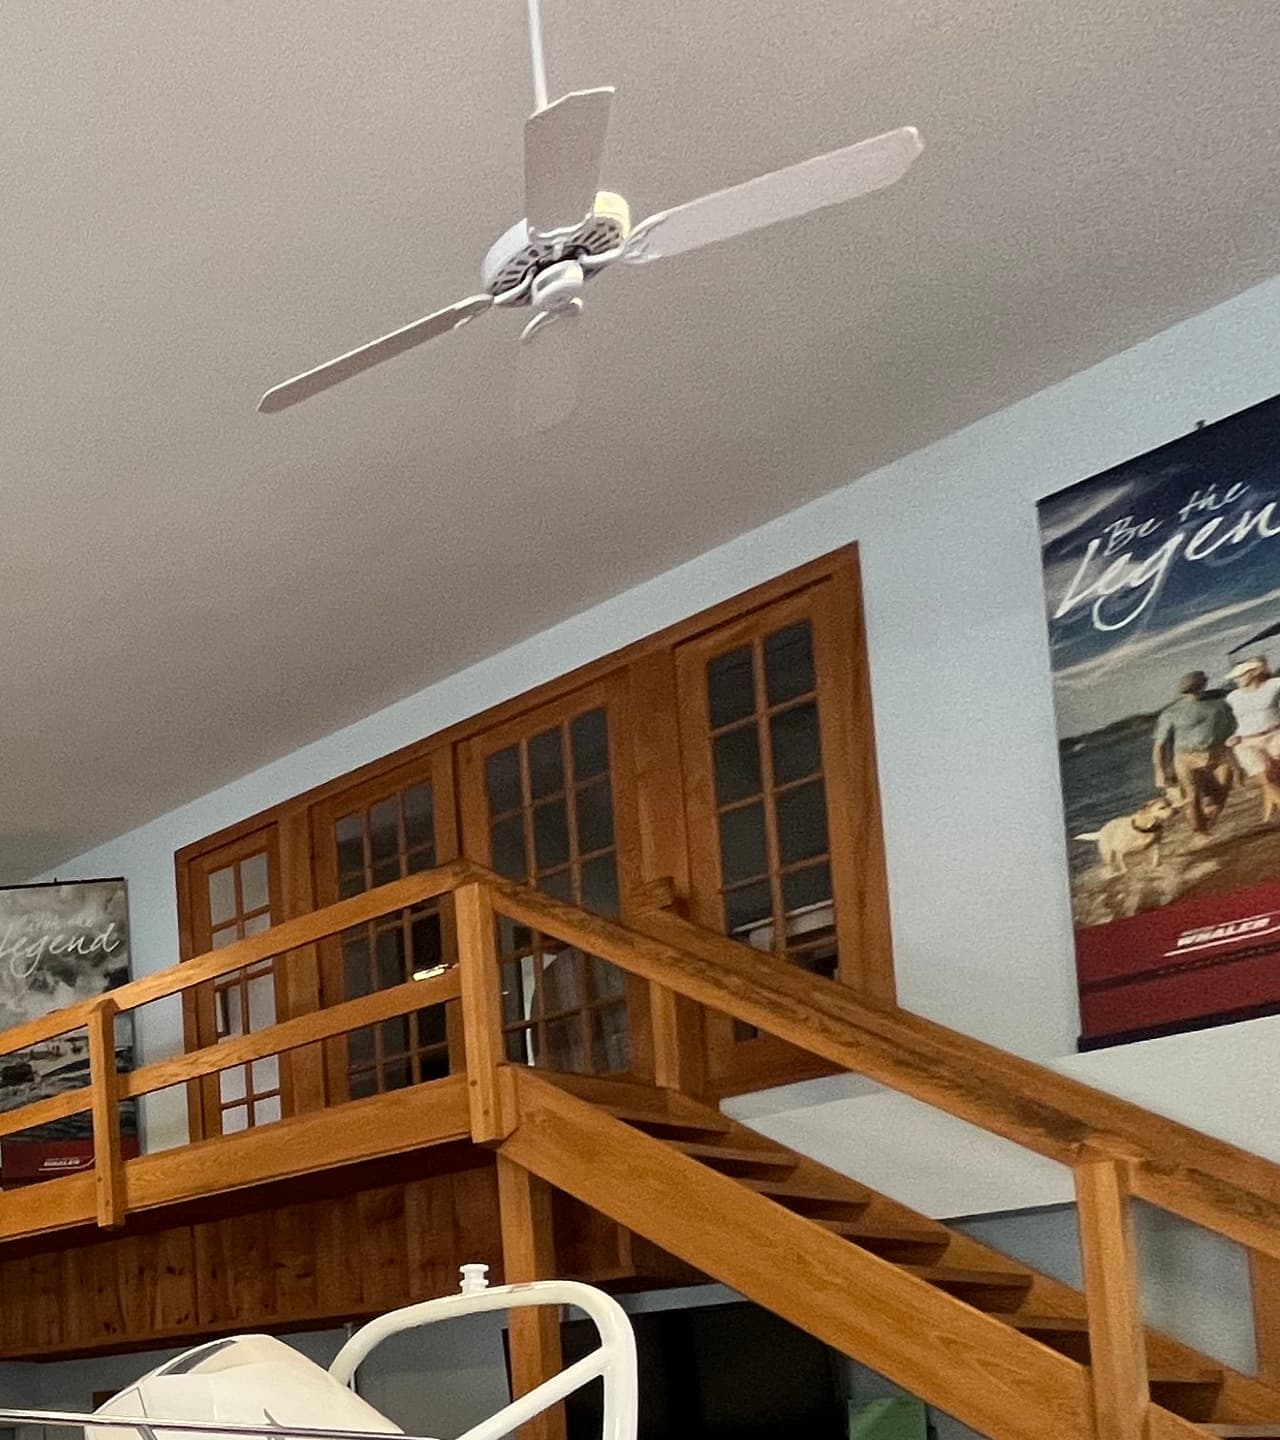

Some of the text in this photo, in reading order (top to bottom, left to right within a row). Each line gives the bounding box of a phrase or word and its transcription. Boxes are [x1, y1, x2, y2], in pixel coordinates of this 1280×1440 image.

[1053, 501, 1280, 632] Legen
[1102, 481, 1250, 556] Be the
